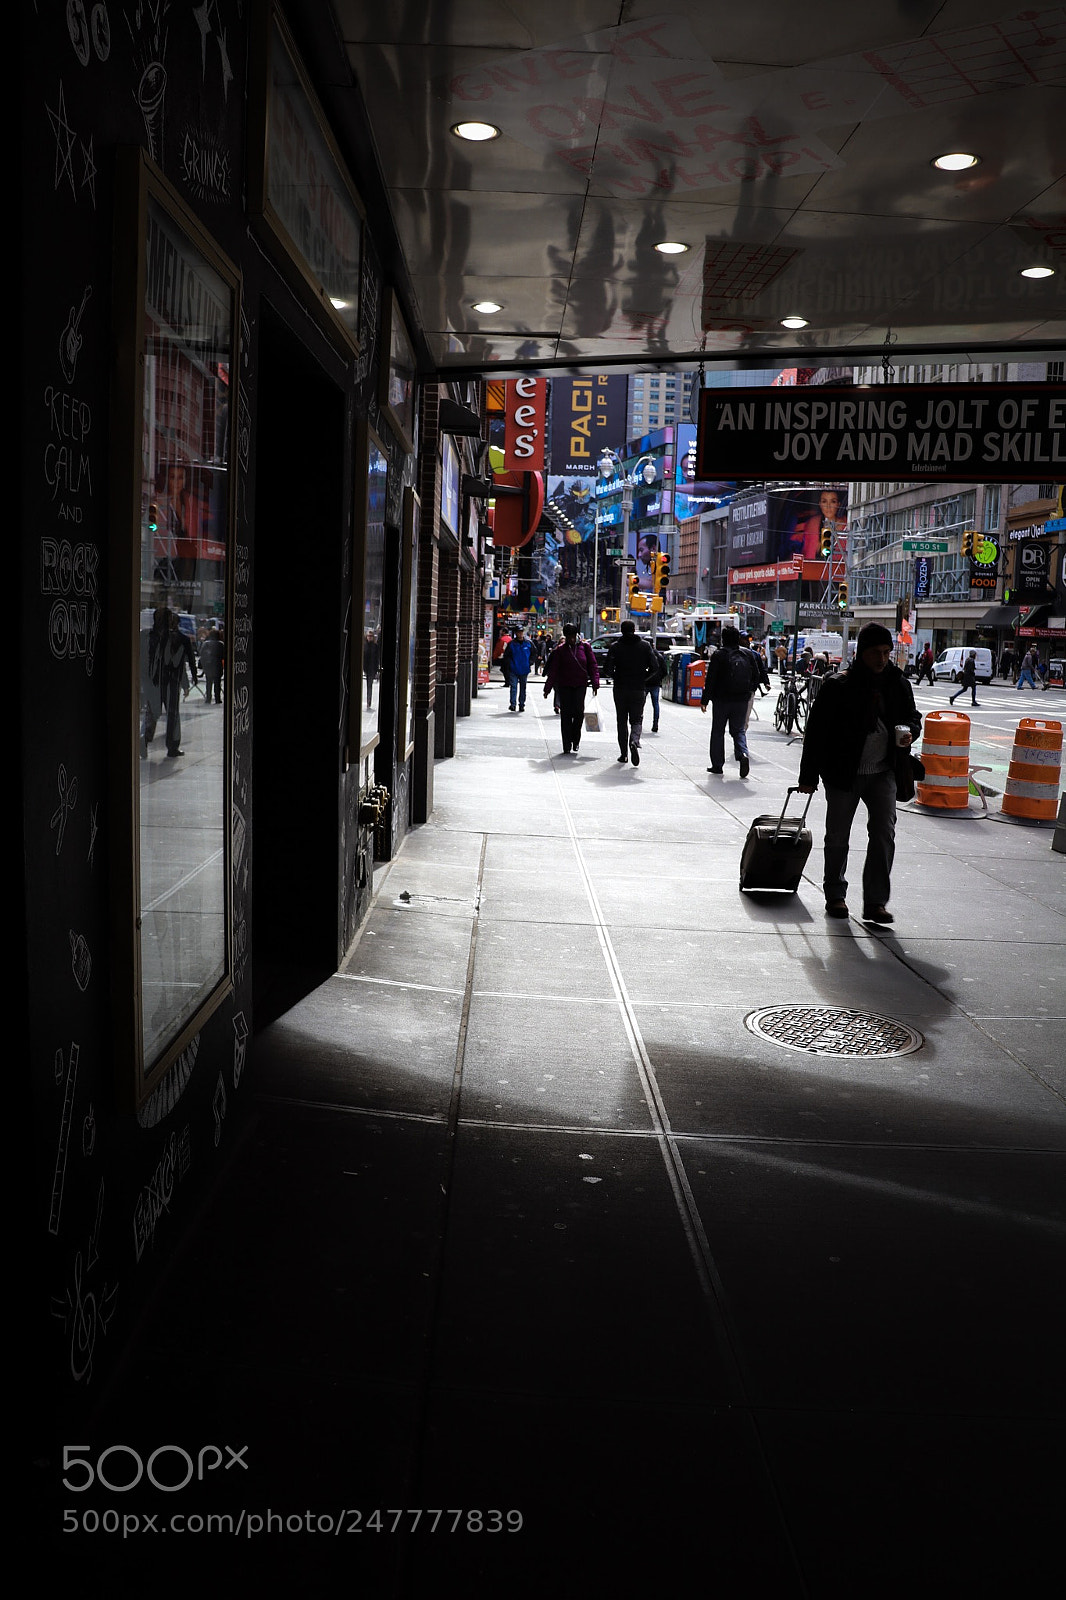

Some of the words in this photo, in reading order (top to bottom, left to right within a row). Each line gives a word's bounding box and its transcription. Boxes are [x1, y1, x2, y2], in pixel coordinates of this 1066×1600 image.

[525, 72, 731, 141] ONE
[44, 384, 91, 444] KEEP
[569, 375, 593, 458] PACI
[764, 400, 908, 431] INSPIRING
[915, 399, 993, 430] JOLT
[997, 399, 1039, 430] OF
[773, 432, 831, 462] JOY
[836, 432, 898, 462] AND
[906, 432, 973, 462] MAD
[982, 432, 1066, 463] SKILL
[44, 442, 93, 501] CALM
[565, 463, 596, 471] MARCH
[57, 502, 84, 525] AND
[911, 542, 918, 550] W
[932, 543, 940, 551] St
[1009, 526, 1031, 541] elegant
[40, 535, 100, 597] ROCK
[1022, 548, 1045, 566] DR
[917, 561, 929, 593] FROZEN
[971, 578, 997, 588] FOOD
